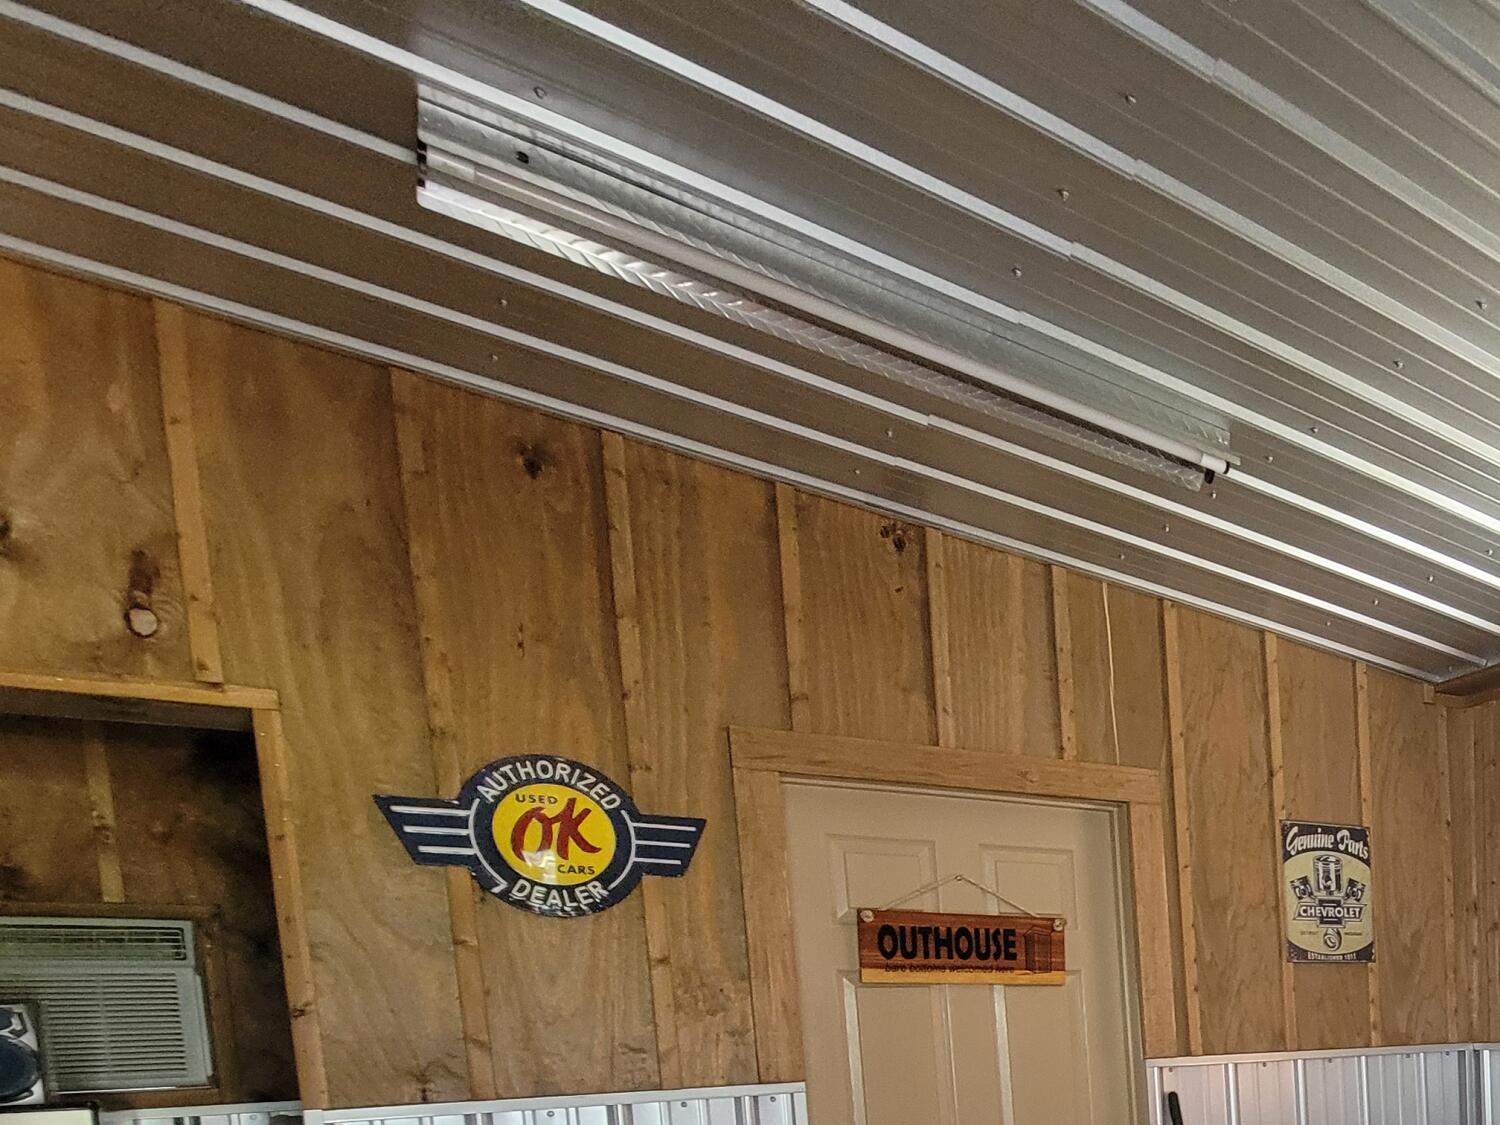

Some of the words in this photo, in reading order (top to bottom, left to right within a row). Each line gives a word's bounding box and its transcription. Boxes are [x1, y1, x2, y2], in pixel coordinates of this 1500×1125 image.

[476, 759, 622, 812] AUTHORIZED
[515, 793, 558, 805] USED
[510, 797, 602, 864] OK
[1286, 826, 1335, 856] Genuine
[1336, 829, 1369, 860] Parts
[557, 864, 596, 875] CARS
[511, 880, 609, 906] DEALER
[1300, 906, 1361, 918] CHEVROLET
[877, 924, 1018, 961] OUTHOUSE
